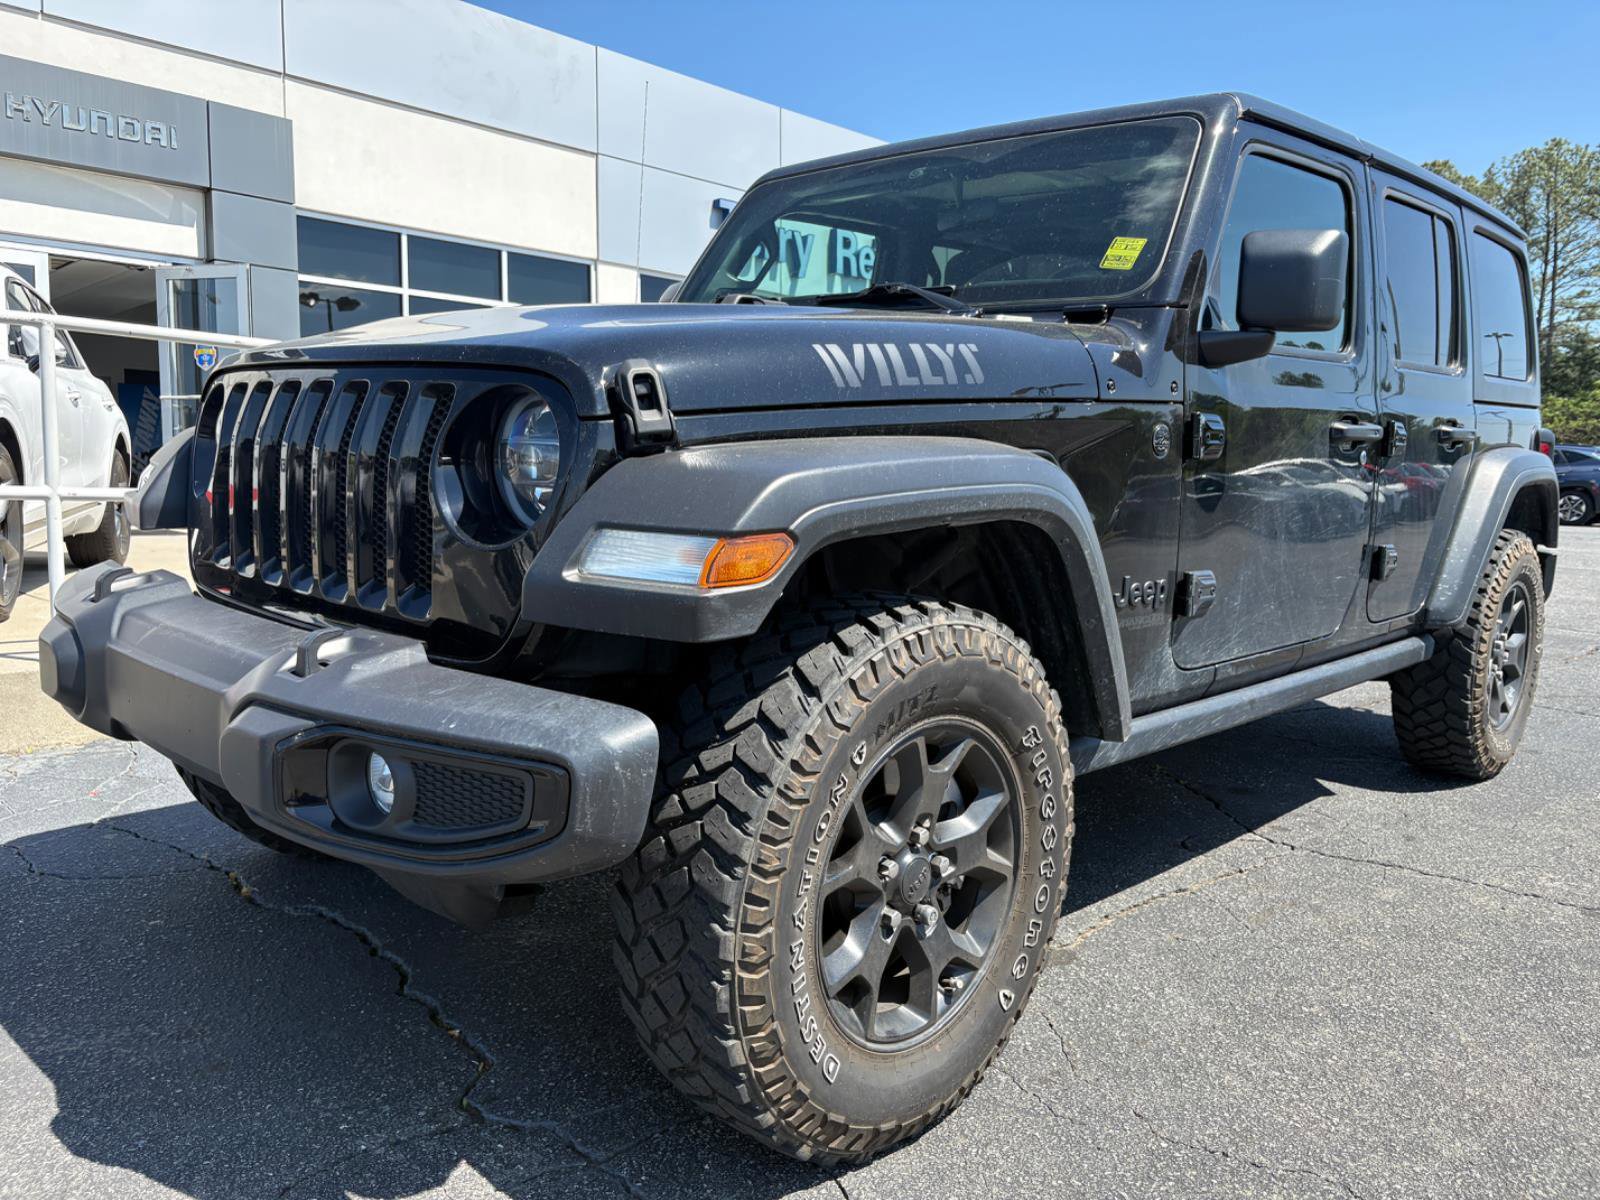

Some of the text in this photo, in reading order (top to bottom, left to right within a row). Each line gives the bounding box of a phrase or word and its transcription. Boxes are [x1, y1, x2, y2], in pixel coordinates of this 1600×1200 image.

[5, 92, 178, 149] HYUNDAI
[812, 343, 985, 388] WILLYS
[1113, 575, 1168, 609] Jeep
[1012, 725, 1058, 980] Firestone
[788, 772, 850, 1084] DESTINATION
